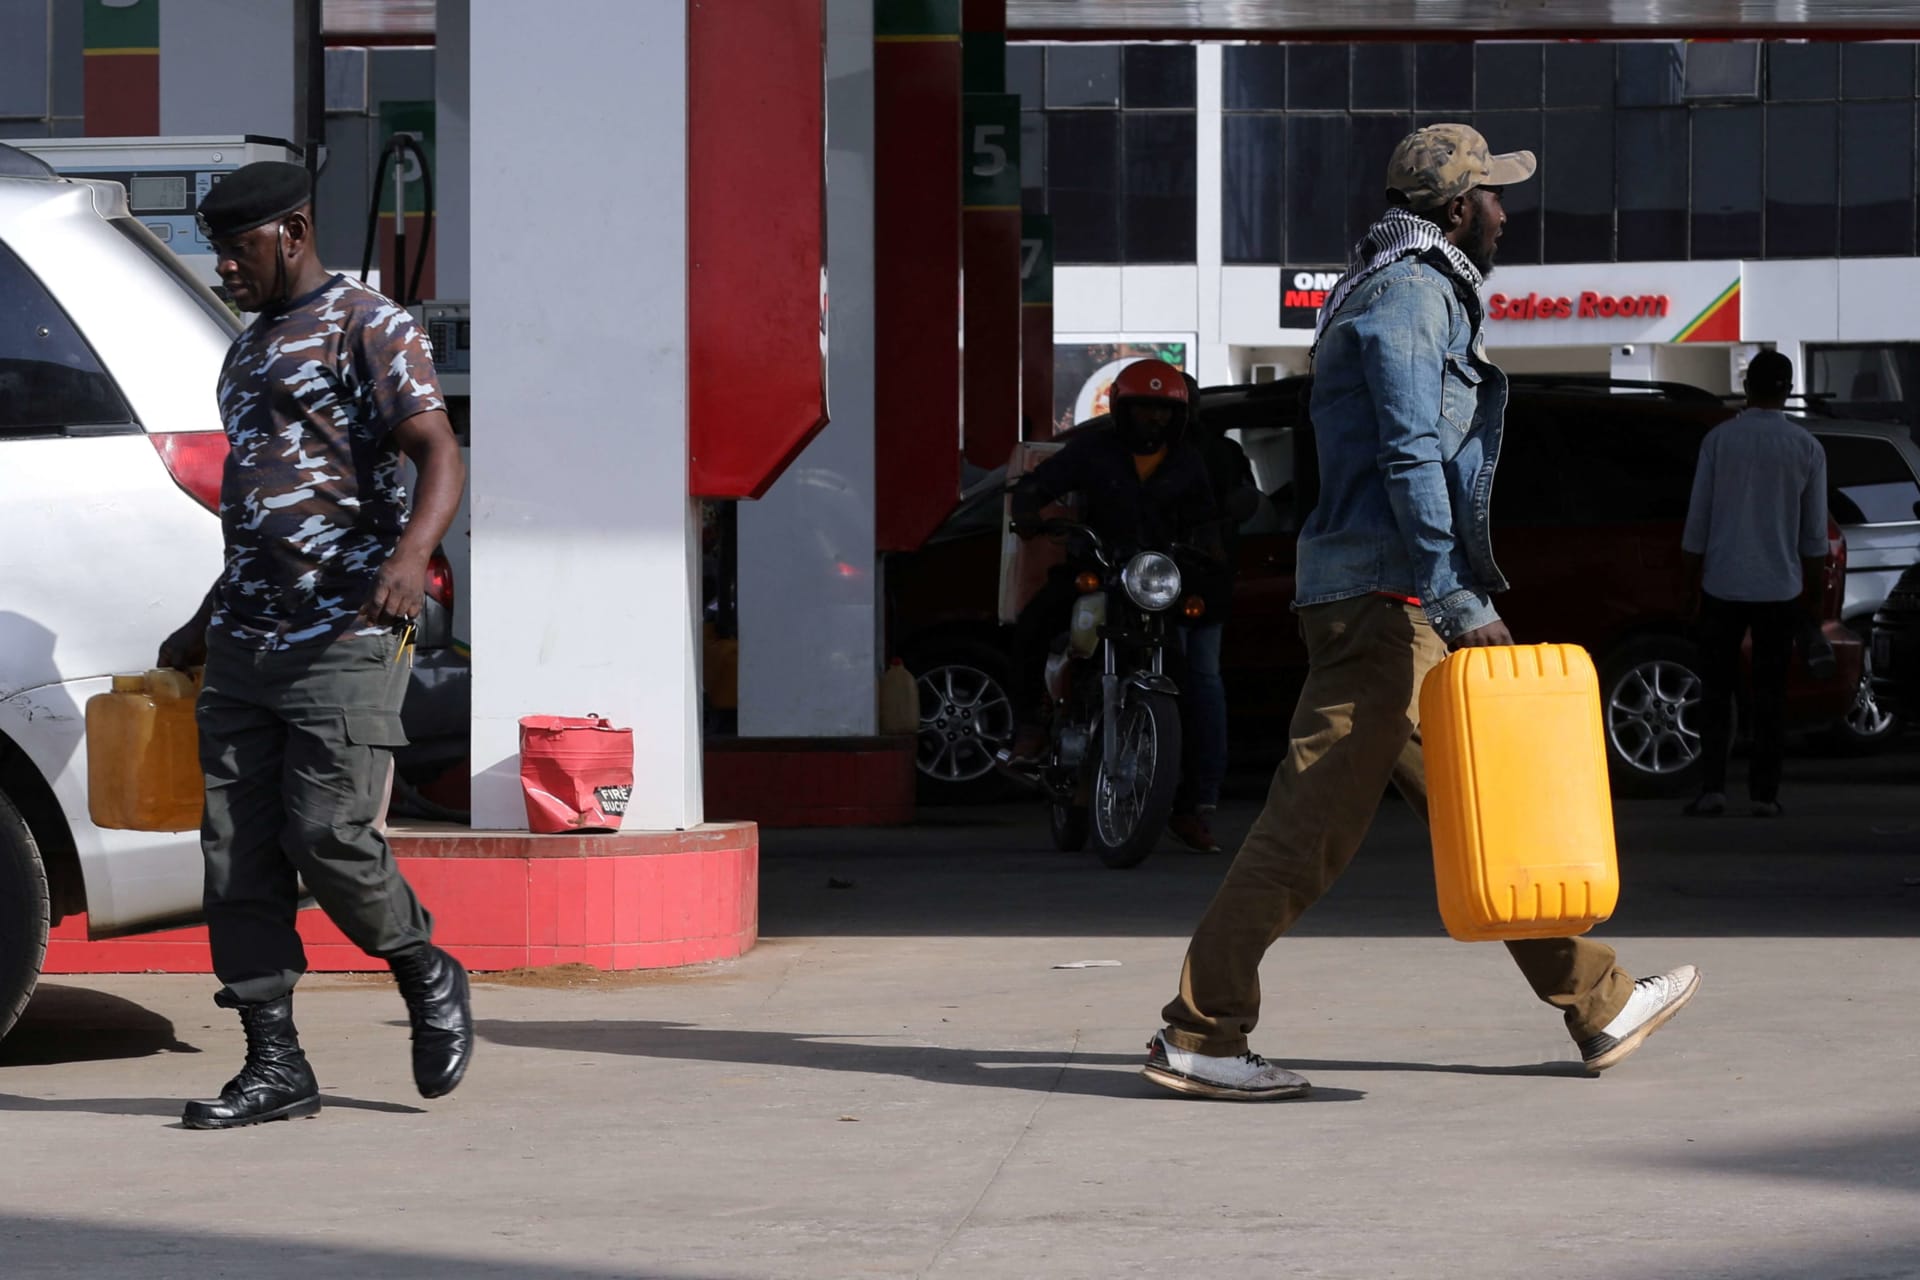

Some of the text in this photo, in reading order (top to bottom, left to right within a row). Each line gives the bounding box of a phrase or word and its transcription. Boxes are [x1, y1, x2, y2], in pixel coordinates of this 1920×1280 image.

[973, 125, 1007, 176] 5
[1293, 272, 1346, 291] OM
[1284, 290, 1329, 307] ME
[1489, 291, 1669, 320] Sales Room
[601, 788, 628, 800] FIRE
